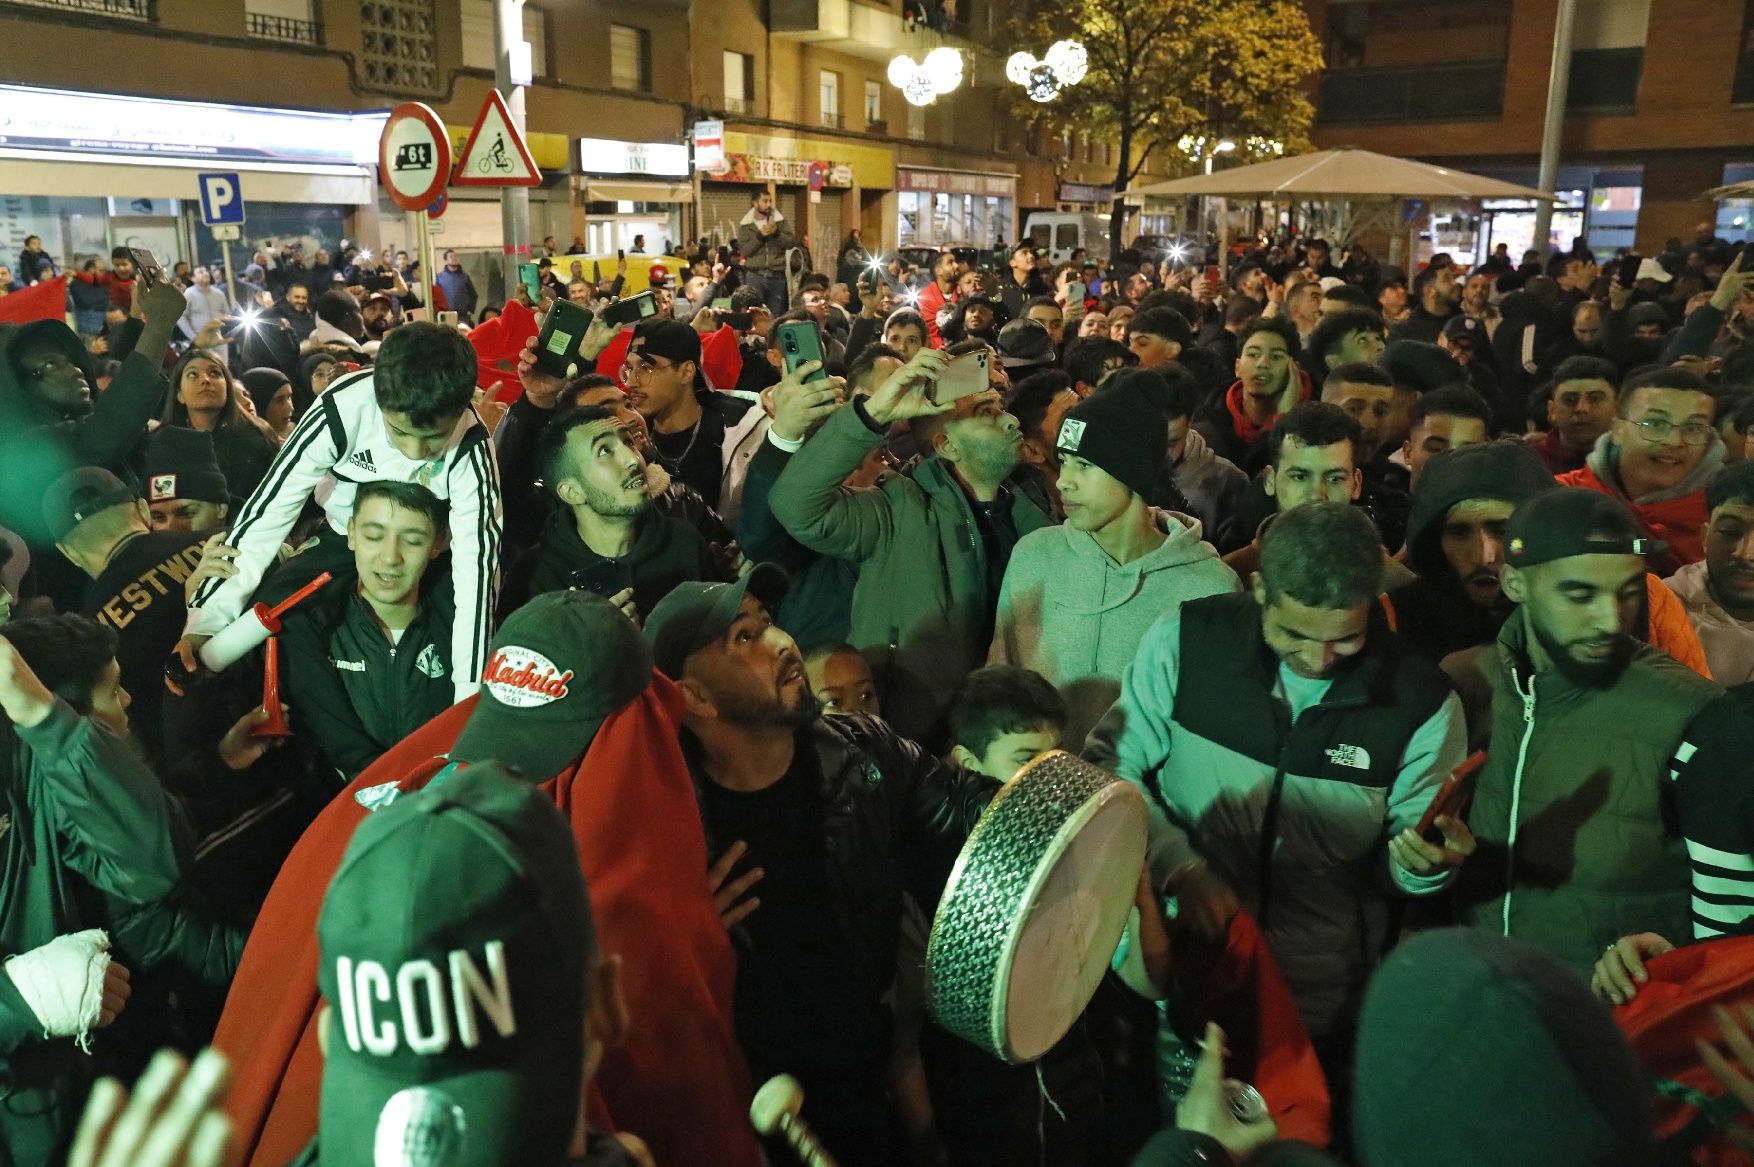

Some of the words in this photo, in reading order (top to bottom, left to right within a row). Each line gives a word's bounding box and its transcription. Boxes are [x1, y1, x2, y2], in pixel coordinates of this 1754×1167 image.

[408, 145, 426, 163] 6t
[772, 162, 809, 178] FRUITERI
[206, 177, 234, 219] P
[349, 456, 377, 474] adidas
[96, 540, 207, 630] ESTWO
[533, 655, 552, 668] CITY
[482, 650, 573, 698] Madrid
[503, 695, 522, 705] 1561
[336, 940, 516, 1056] ICON
